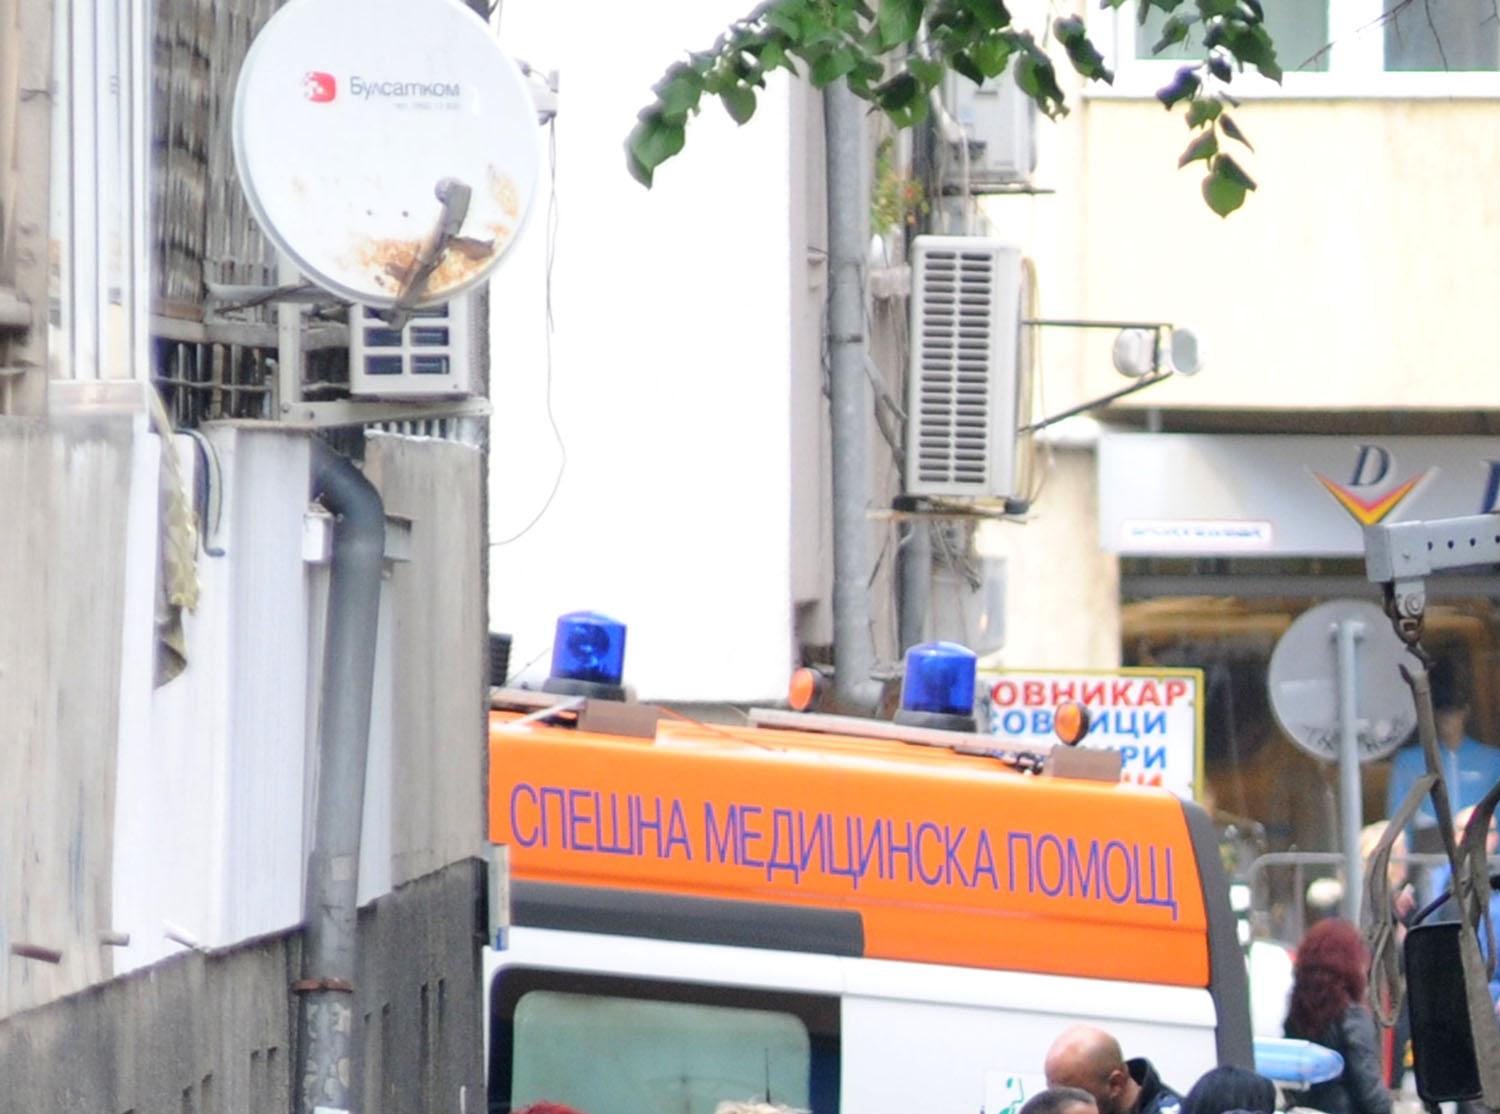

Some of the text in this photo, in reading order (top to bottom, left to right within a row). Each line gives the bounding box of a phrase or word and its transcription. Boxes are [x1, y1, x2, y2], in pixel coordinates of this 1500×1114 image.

[349, 75, 460, 101] Булсатком
[509, 783, 1178, 920] СПЕШНА МЕДИЦИНСКА ПОМОЩ
